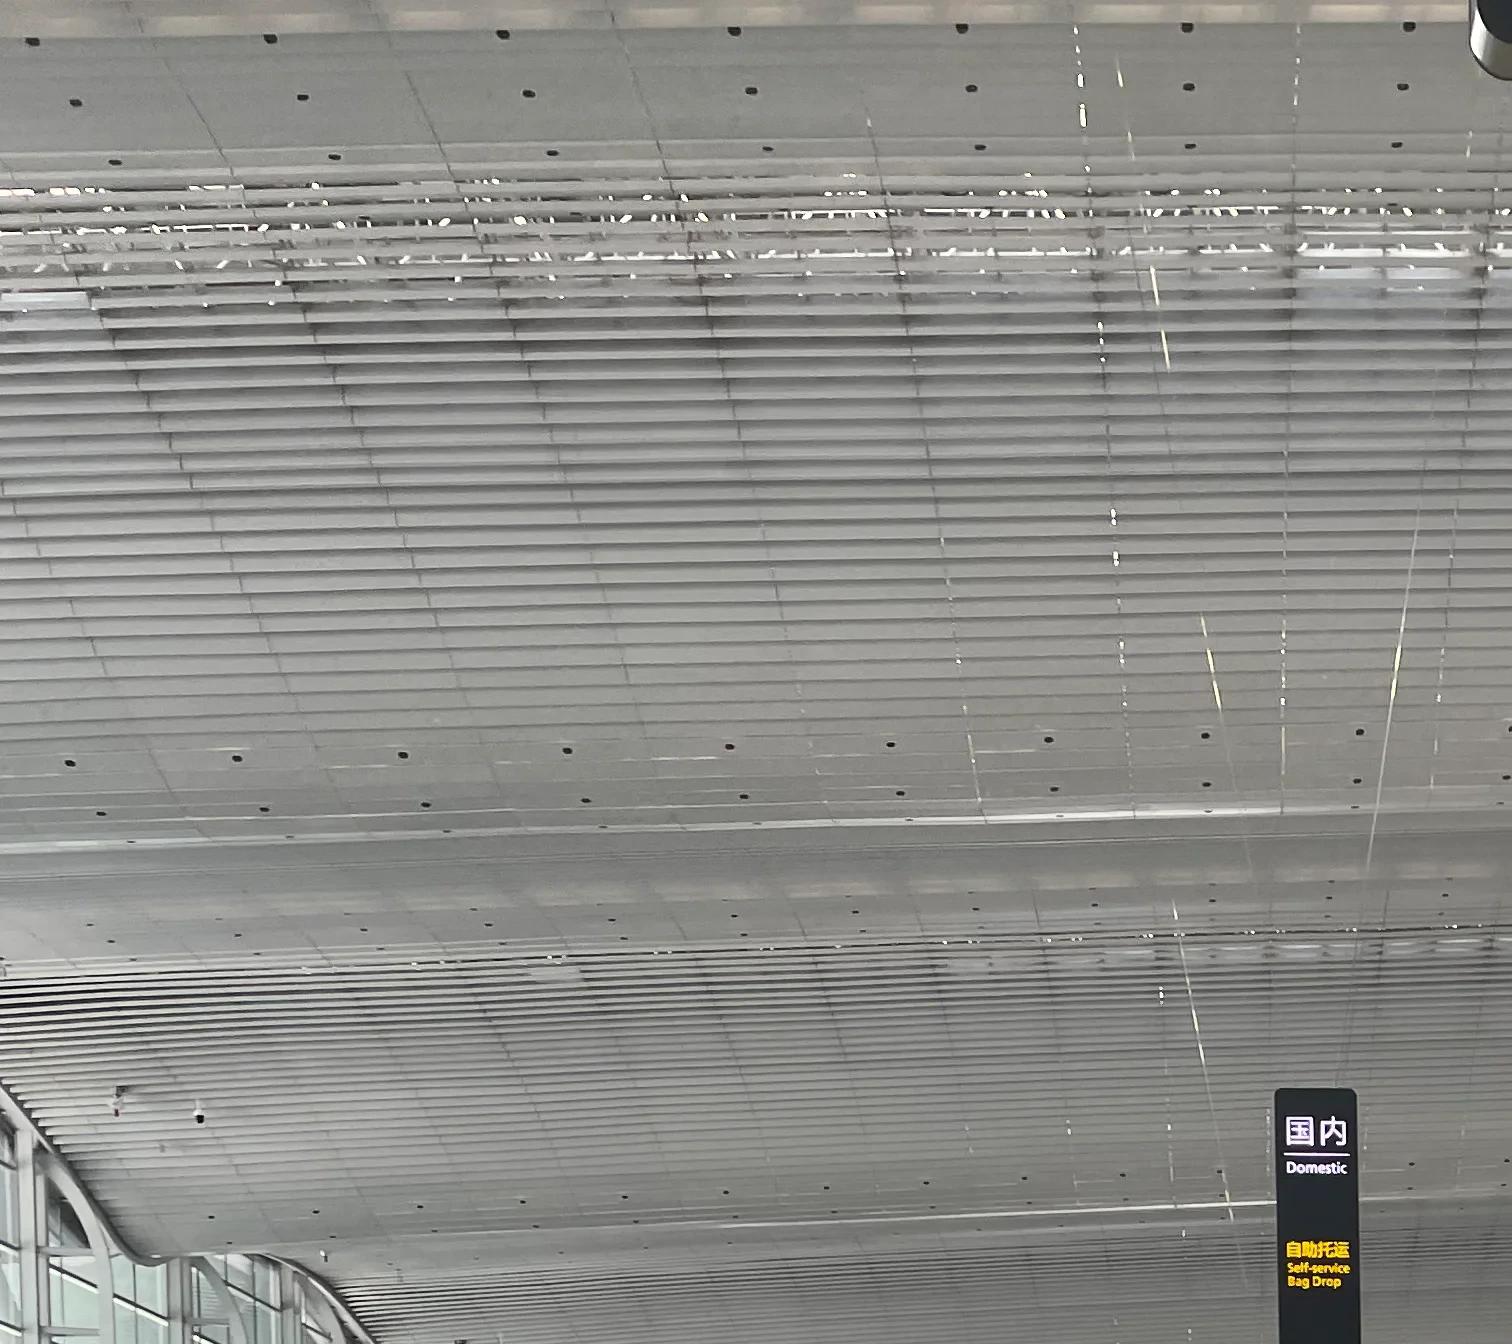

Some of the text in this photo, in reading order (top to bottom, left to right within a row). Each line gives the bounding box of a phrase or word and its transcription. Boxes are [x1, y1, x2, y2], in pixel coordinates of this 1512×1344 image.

[1285, 1115, 1347, 1147] 国内
[1286, 1161, 1348, 1175] Domestic
[1286, 1241, 1350, 1259] 自助托运
[1287, 1262, 1351, 1274] Self-service
[1288, 1275, 1342, 1290] Bag Drop
